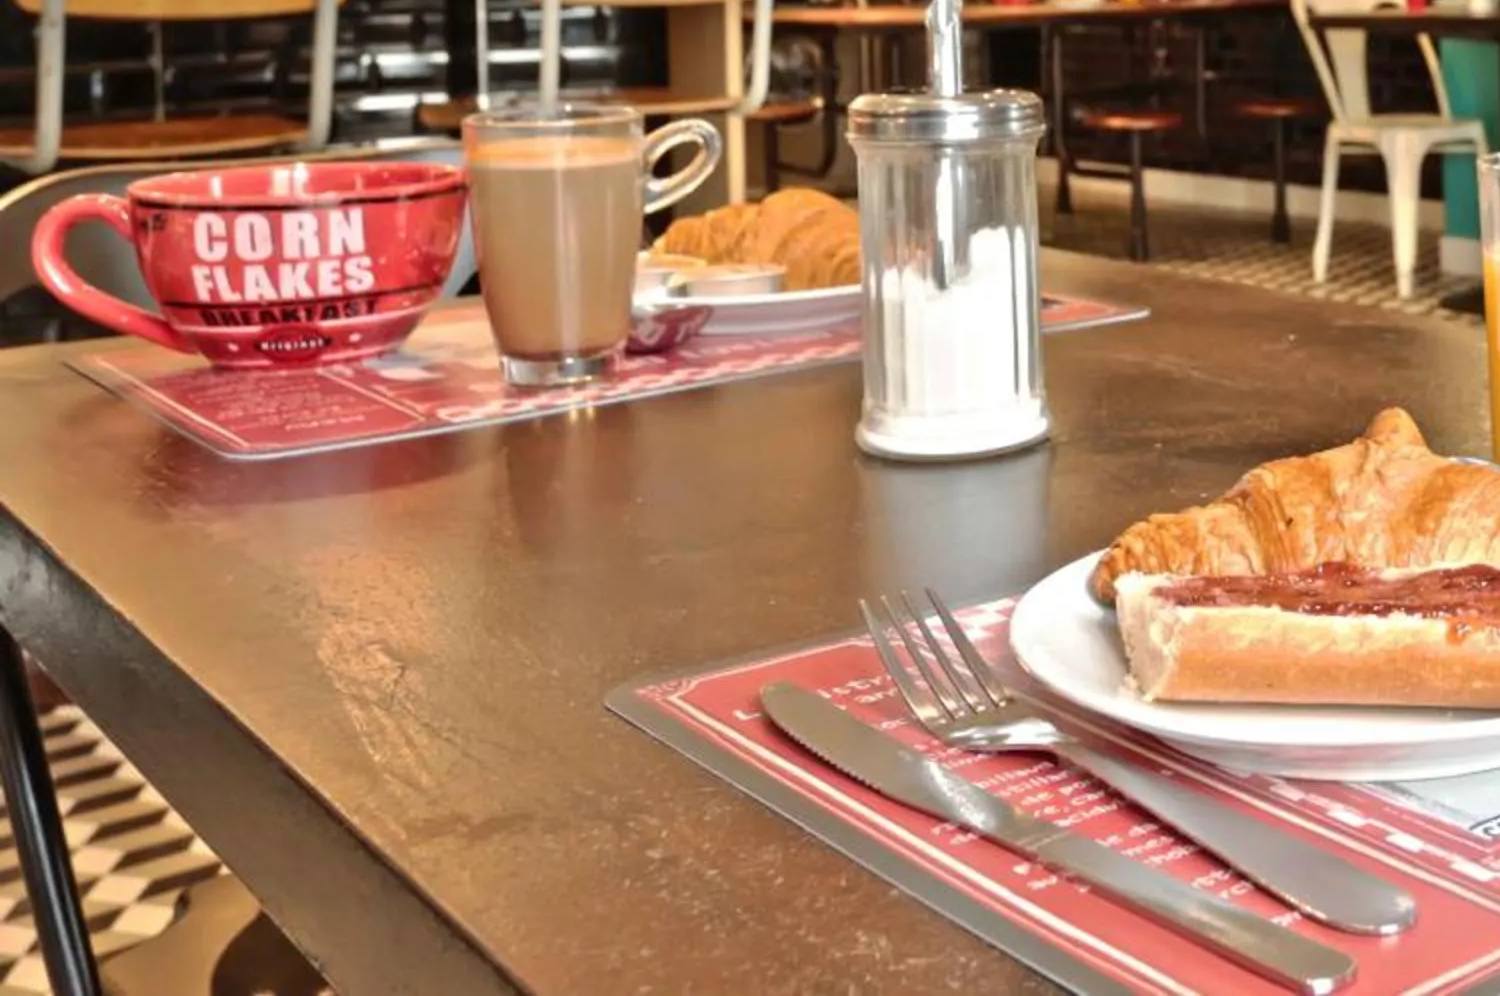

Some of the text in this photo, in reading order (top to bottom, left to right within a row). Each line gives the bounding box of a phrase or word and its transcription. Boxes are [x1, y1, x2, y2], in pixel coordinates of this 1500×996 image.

[193, 207, 365, 262] CORN
[191, 256, 375, 303] FLAKES
[200, 300, 377, 327] BREAKFAST
